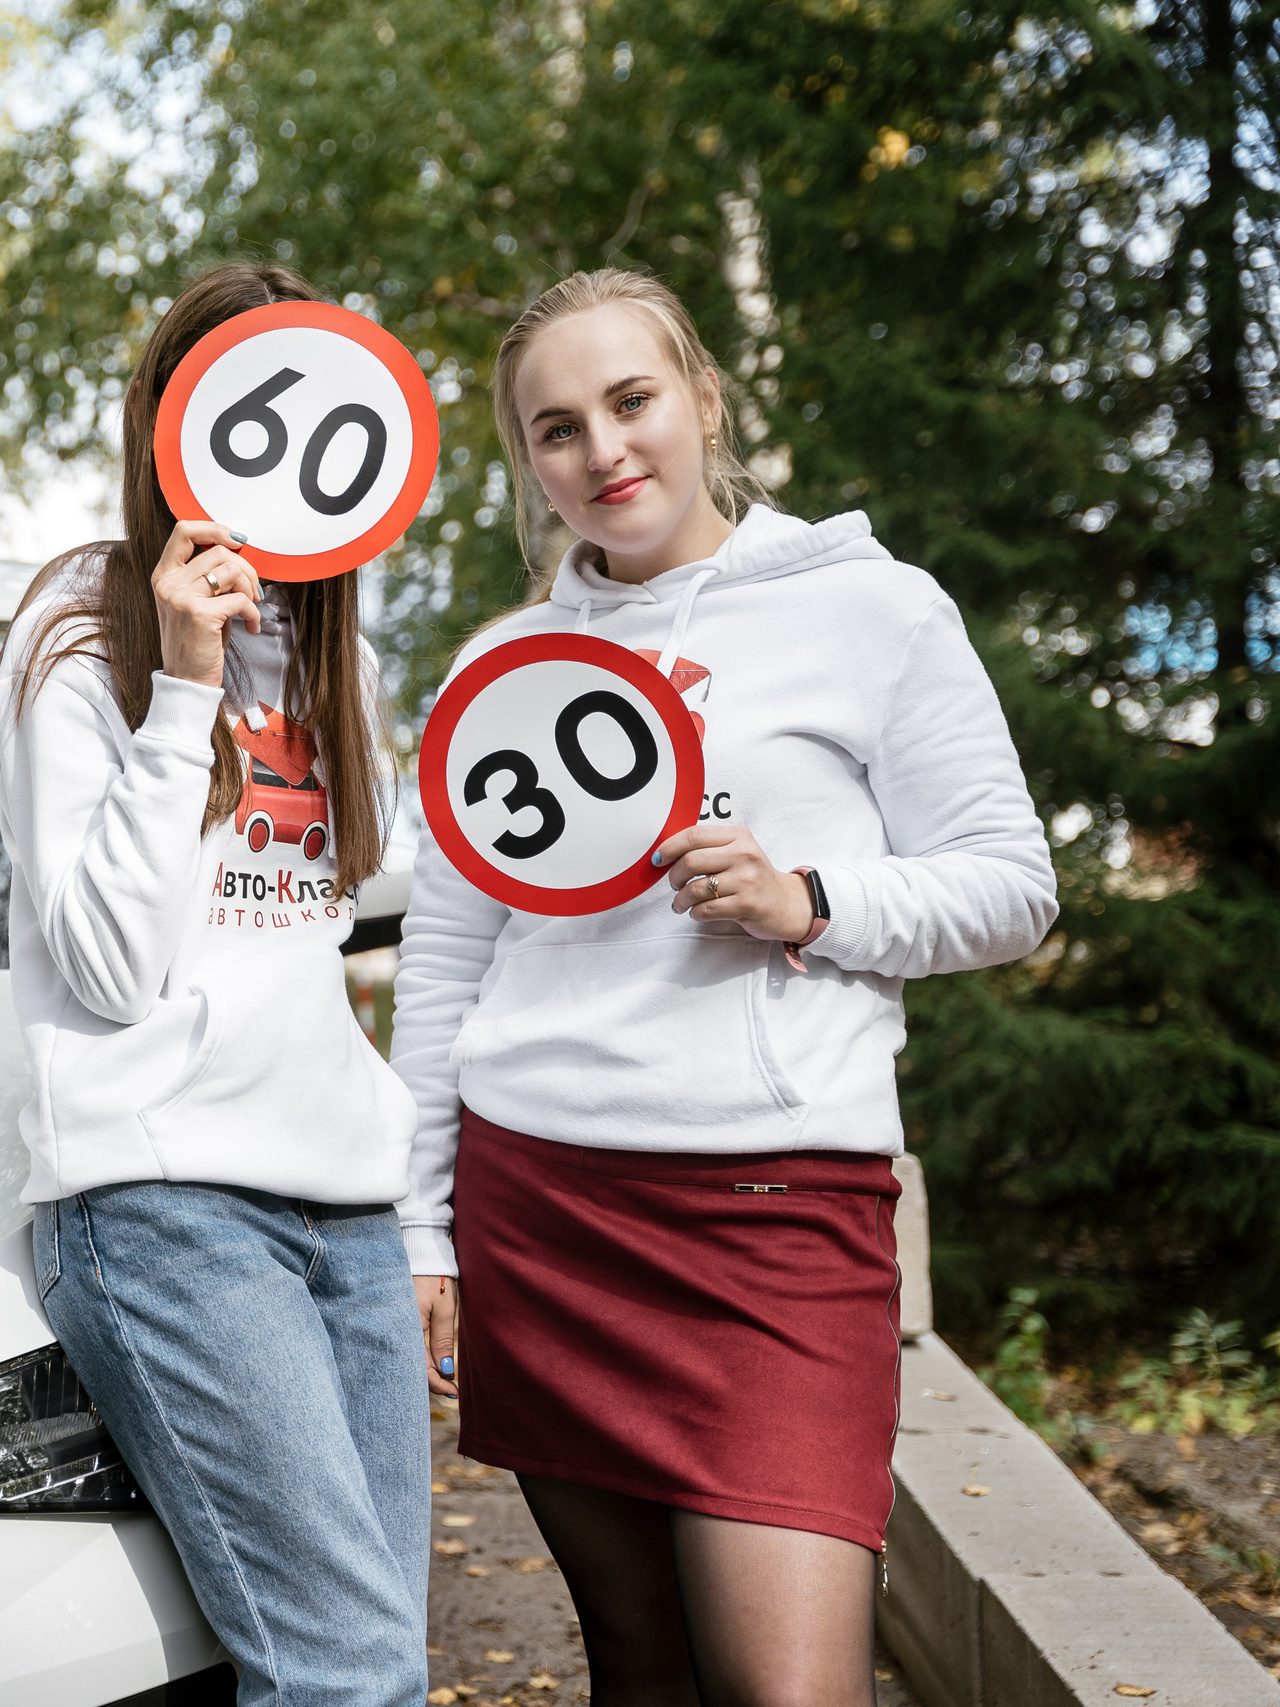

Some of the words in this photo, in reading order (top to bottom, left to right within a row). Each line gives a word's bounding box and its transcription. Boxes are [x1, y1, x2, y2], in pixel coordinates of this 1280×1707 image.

[209, 366, 388, 516] 60
[463, 690, 659, 860] 30
[208, 905, 354, 928] автошкол
